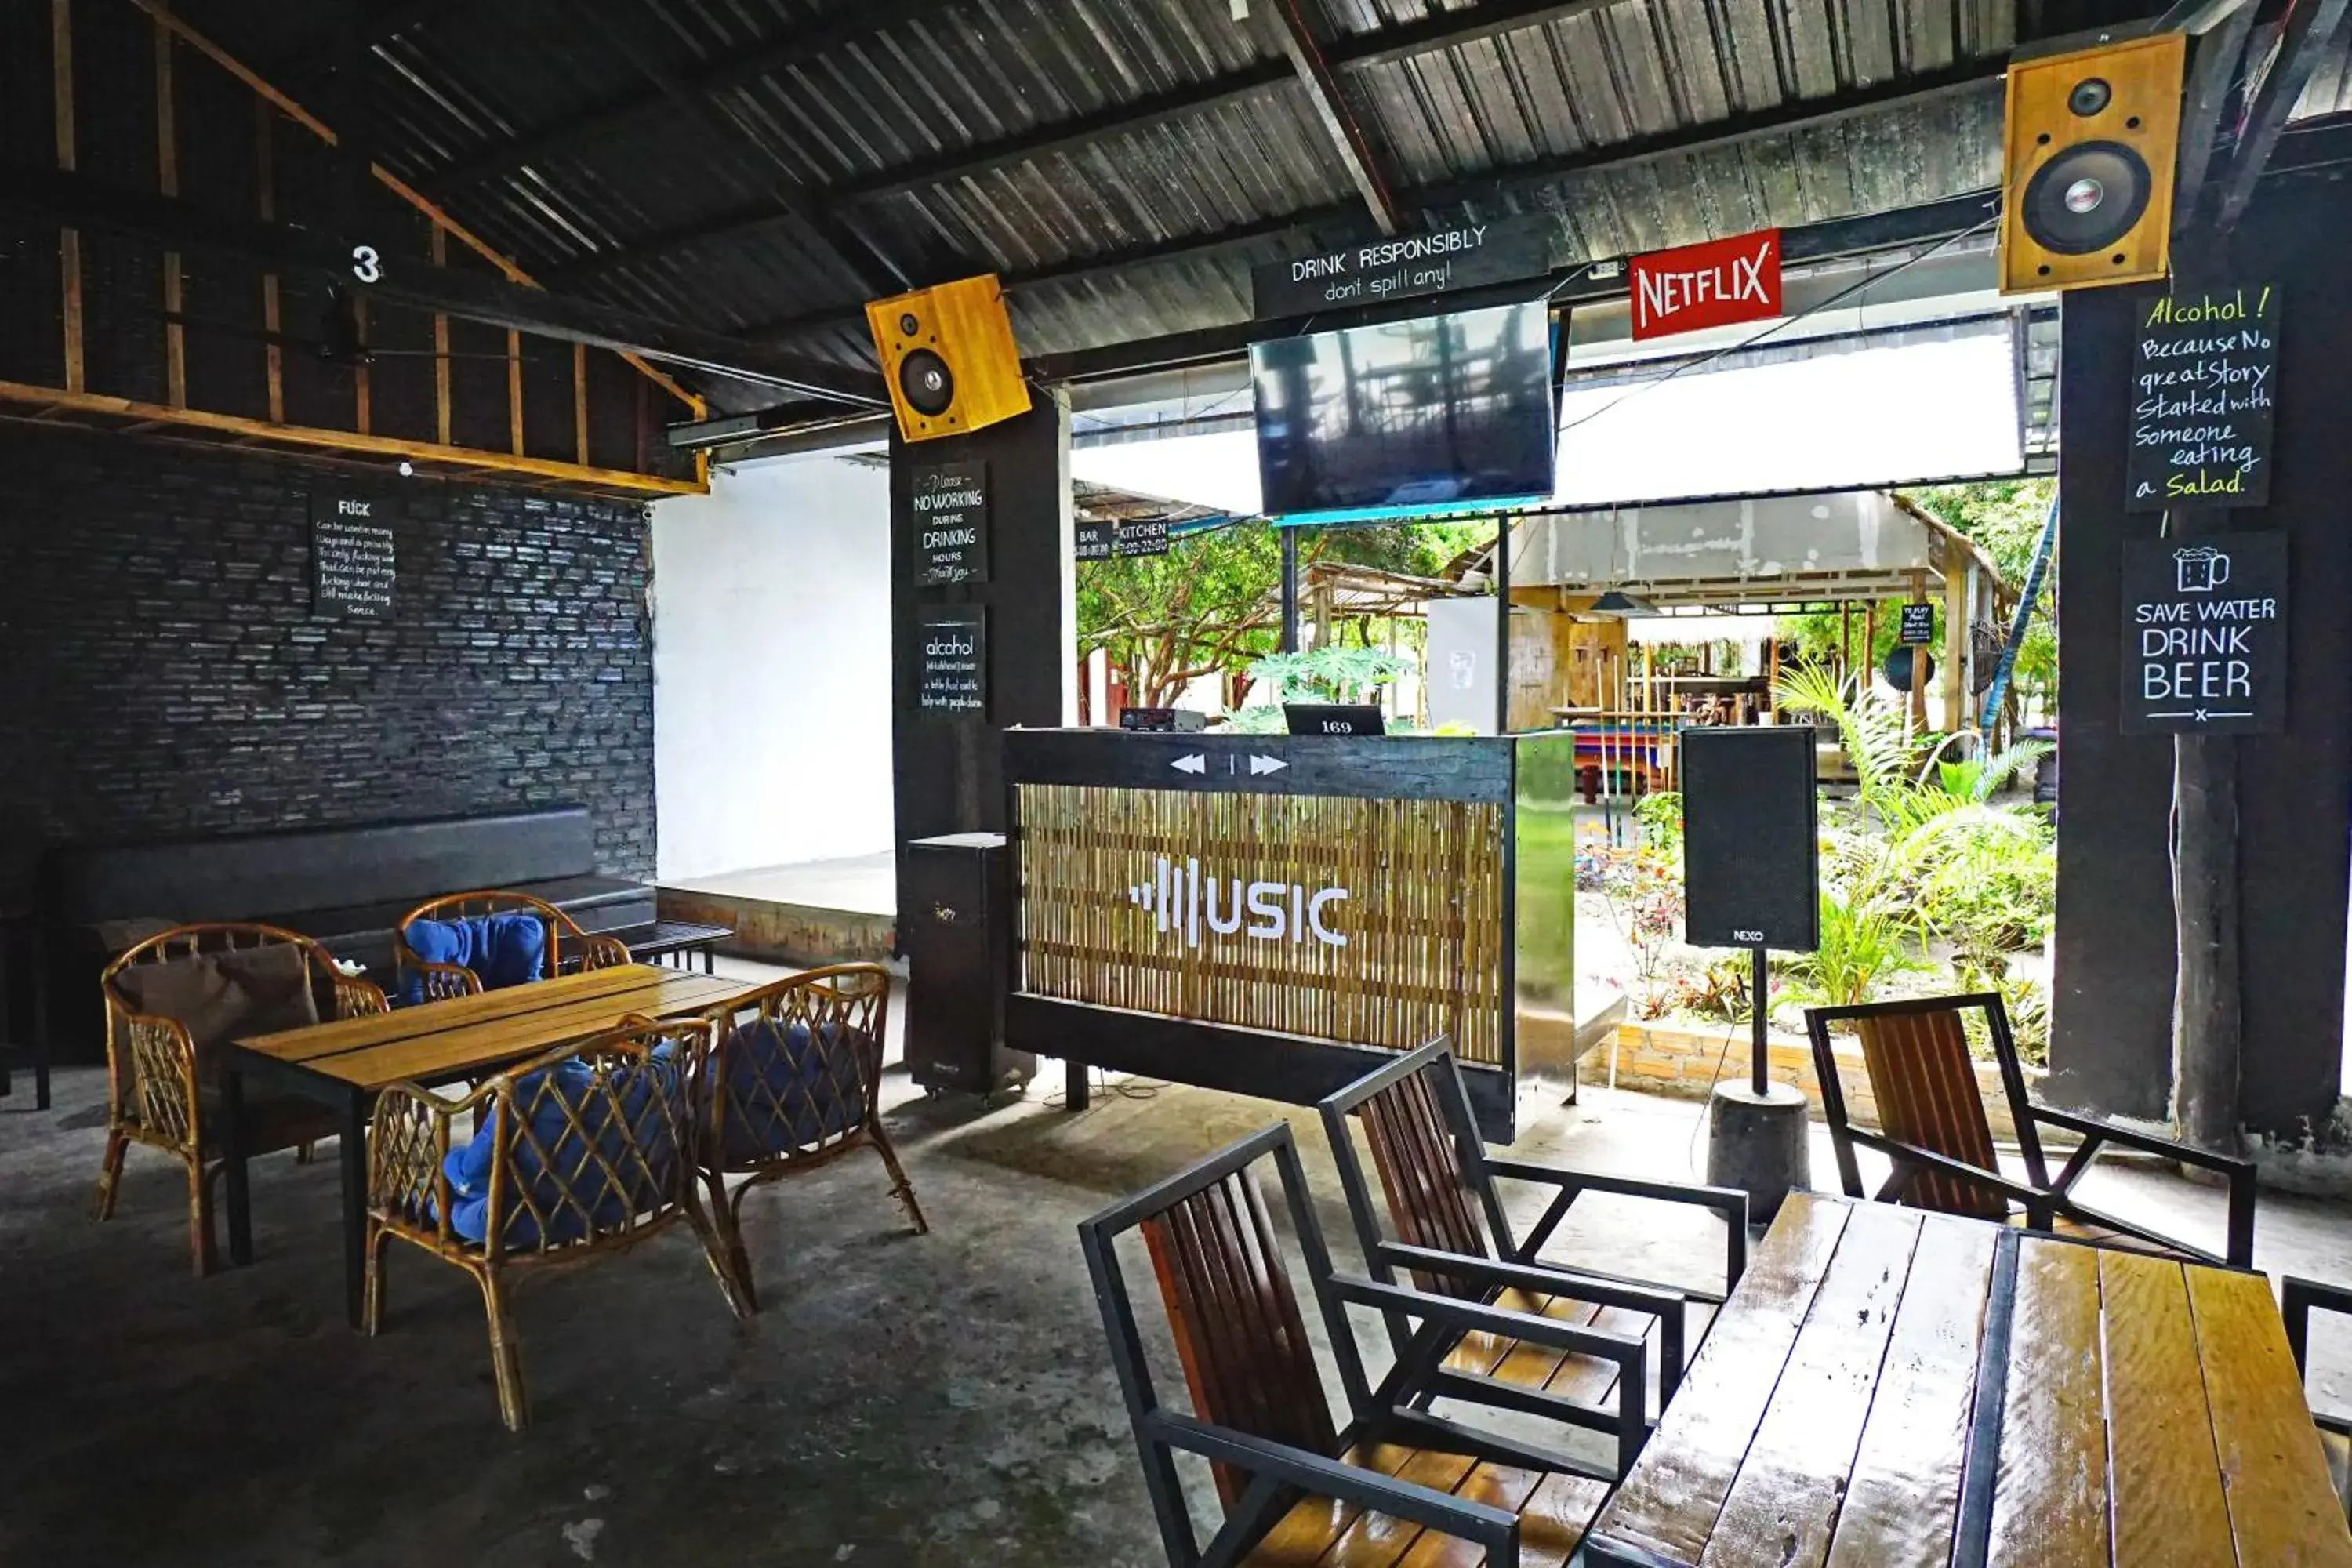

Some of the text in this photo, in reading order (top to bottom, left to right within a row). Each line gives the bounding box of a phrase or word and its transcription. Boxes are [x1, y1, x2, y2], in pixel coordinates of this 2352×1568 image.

[353, 245, 379, 283] 3
[1292, 225, 1487, 281] DRINK RESPONSIBLY
[1370, 268, 1408, 298] spill
[1637, 240, 1770, 329] NETFLIX
[2145, 289, 2246, 328] Alcohol
[2142, 329, 2271, 360] Because No
[2140, 361, 2207, 395] great
[2230, 387, 2272, 411] with
[2169, 443, 2262, 472] eating
[915, 490, 982, 511] NO WORKING
[2136, 481, 2156, 498] a
[338, 499, 371, 517] FUCK
[932, 514, 964, 526] DURING
[923, 528, 976, 550] DRINKING
[1080, 529, 1098, 542] BAR
[1119, 522, 1167, 539] KITCHEN
[932, 551, 963, 563] HOURS
[2136, 598, 2275, 623] SAVE WATER
[926, 634, 973, 655] alcohol
[2143, 626, 2252, 657] DRINK
[2144, 660, 2251, 699] BEER
[1321, 720, 1352, 734] 169
[1733, 930, 1764, 942] NEXO
